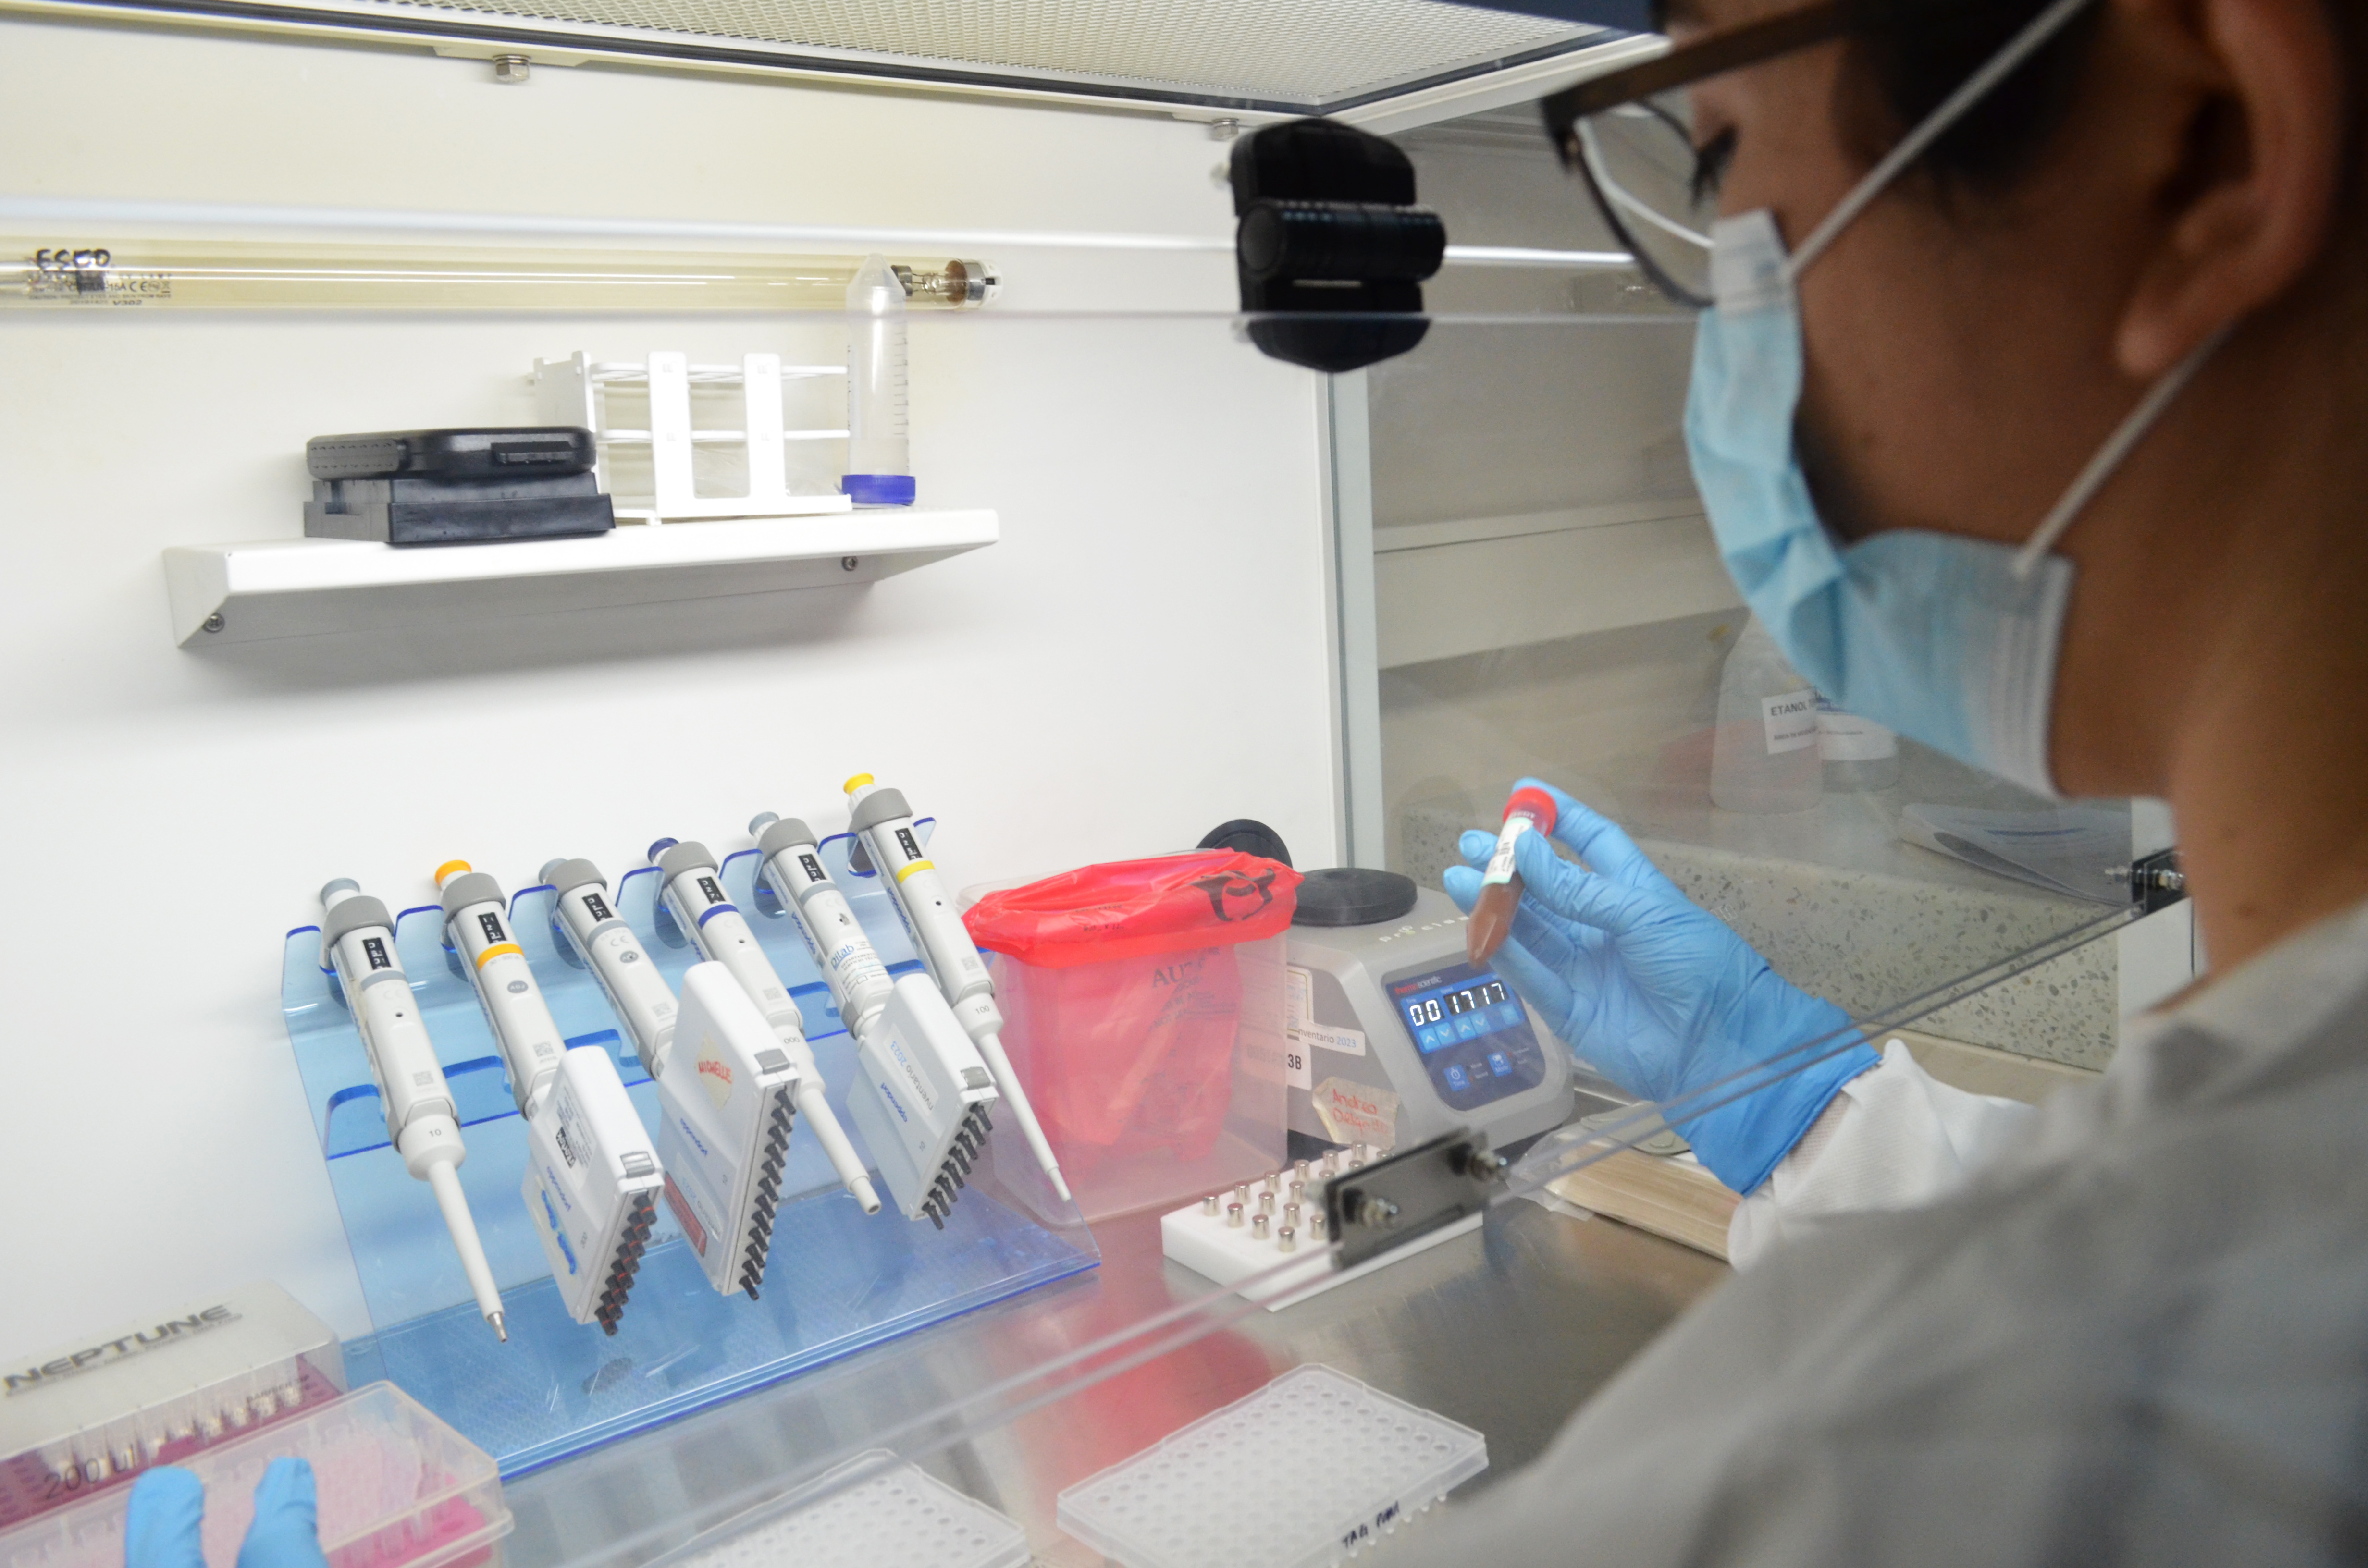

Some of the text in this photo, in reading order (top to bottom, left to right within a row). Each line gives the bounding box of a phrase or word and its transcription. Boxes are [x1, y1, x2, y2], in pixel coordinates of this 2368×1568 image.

[975, 1005, 990, 1015] 100
[1409, 983, 1505, 1026] 00 1717
[890, 1041, 907, 1067] 2023
[1336, 1036, 1357, 1048] 2023
[429, 1128, 441, 1137] 10
[3, 1304, 233, 1390] NEPTUNE
[45, 1458, 100, 1499] 200
